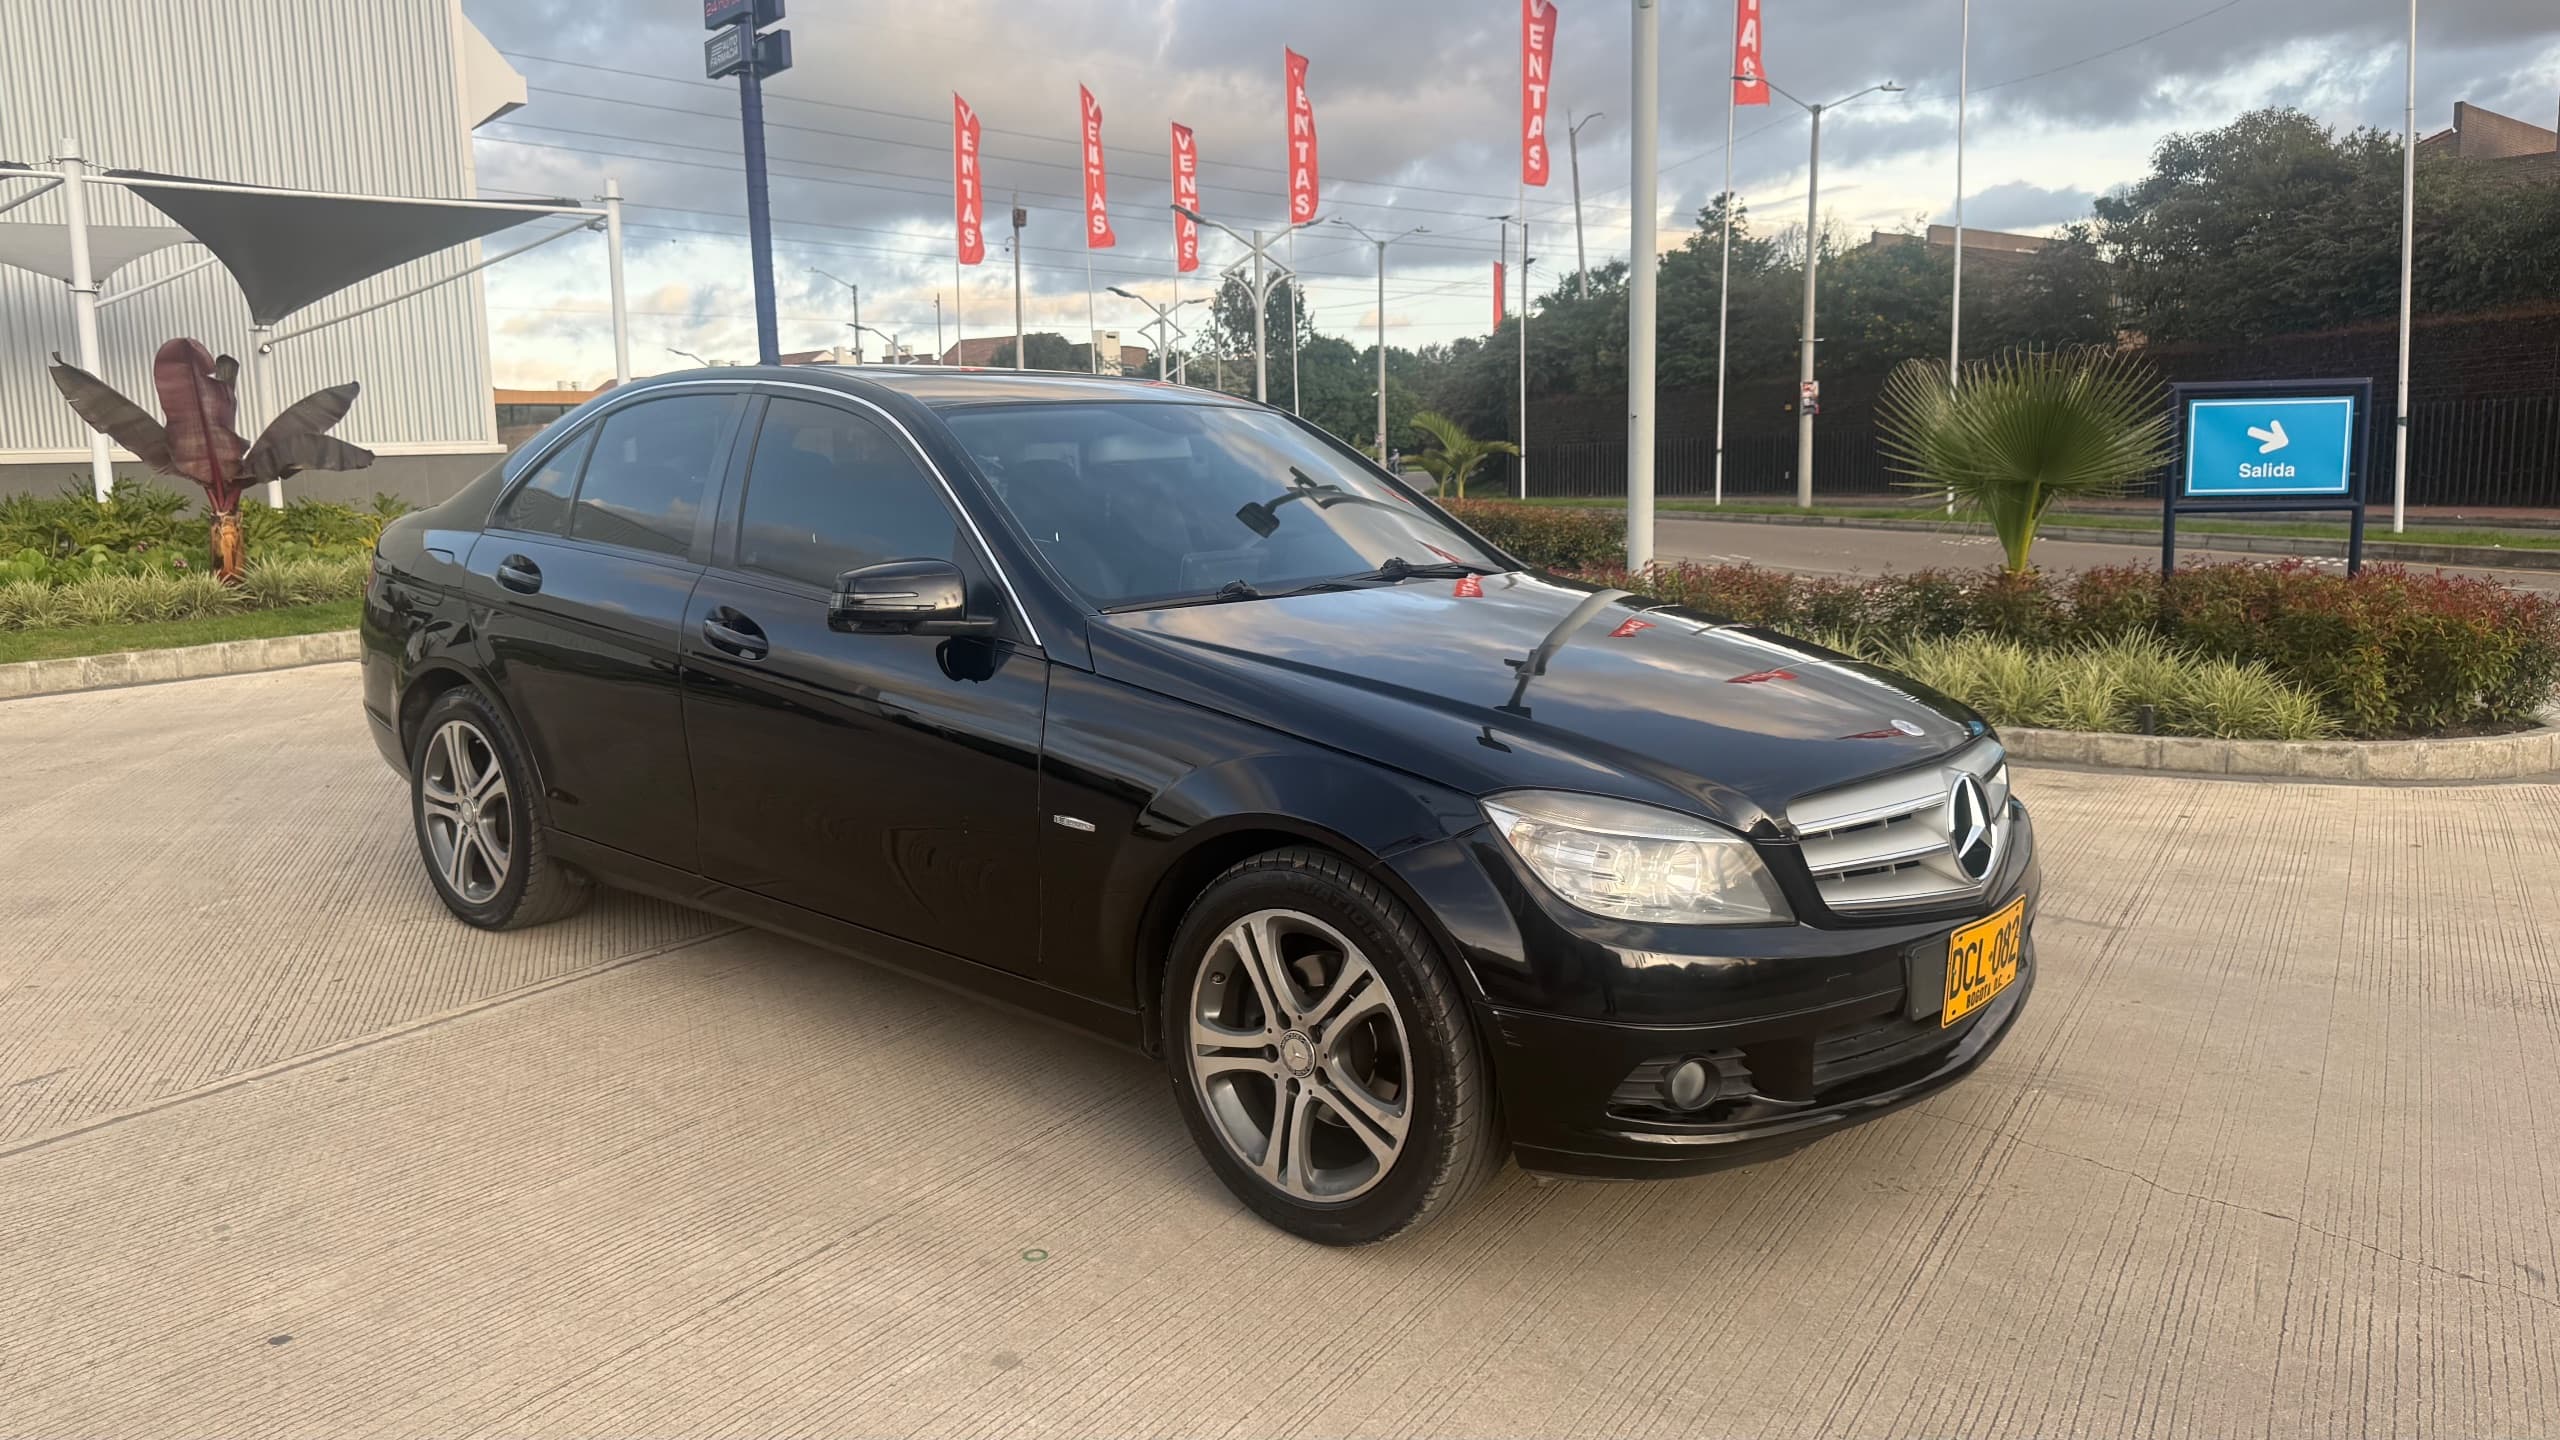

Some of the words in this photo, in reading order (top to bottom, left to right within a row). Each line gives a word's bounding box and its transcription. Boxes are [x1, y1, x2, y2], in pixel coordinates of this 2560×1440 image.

[1527, 0, 1546, 171] VENTAS
[959, 105, 976, 248] VENTAS
[1085, 96, 1106, 235] VENTAS
[1174, 130, 1196, 259] VENTAS
[2239, 462, 2295, 479] Salida
[1966, 983, 1991, 1009] BOGOTA
